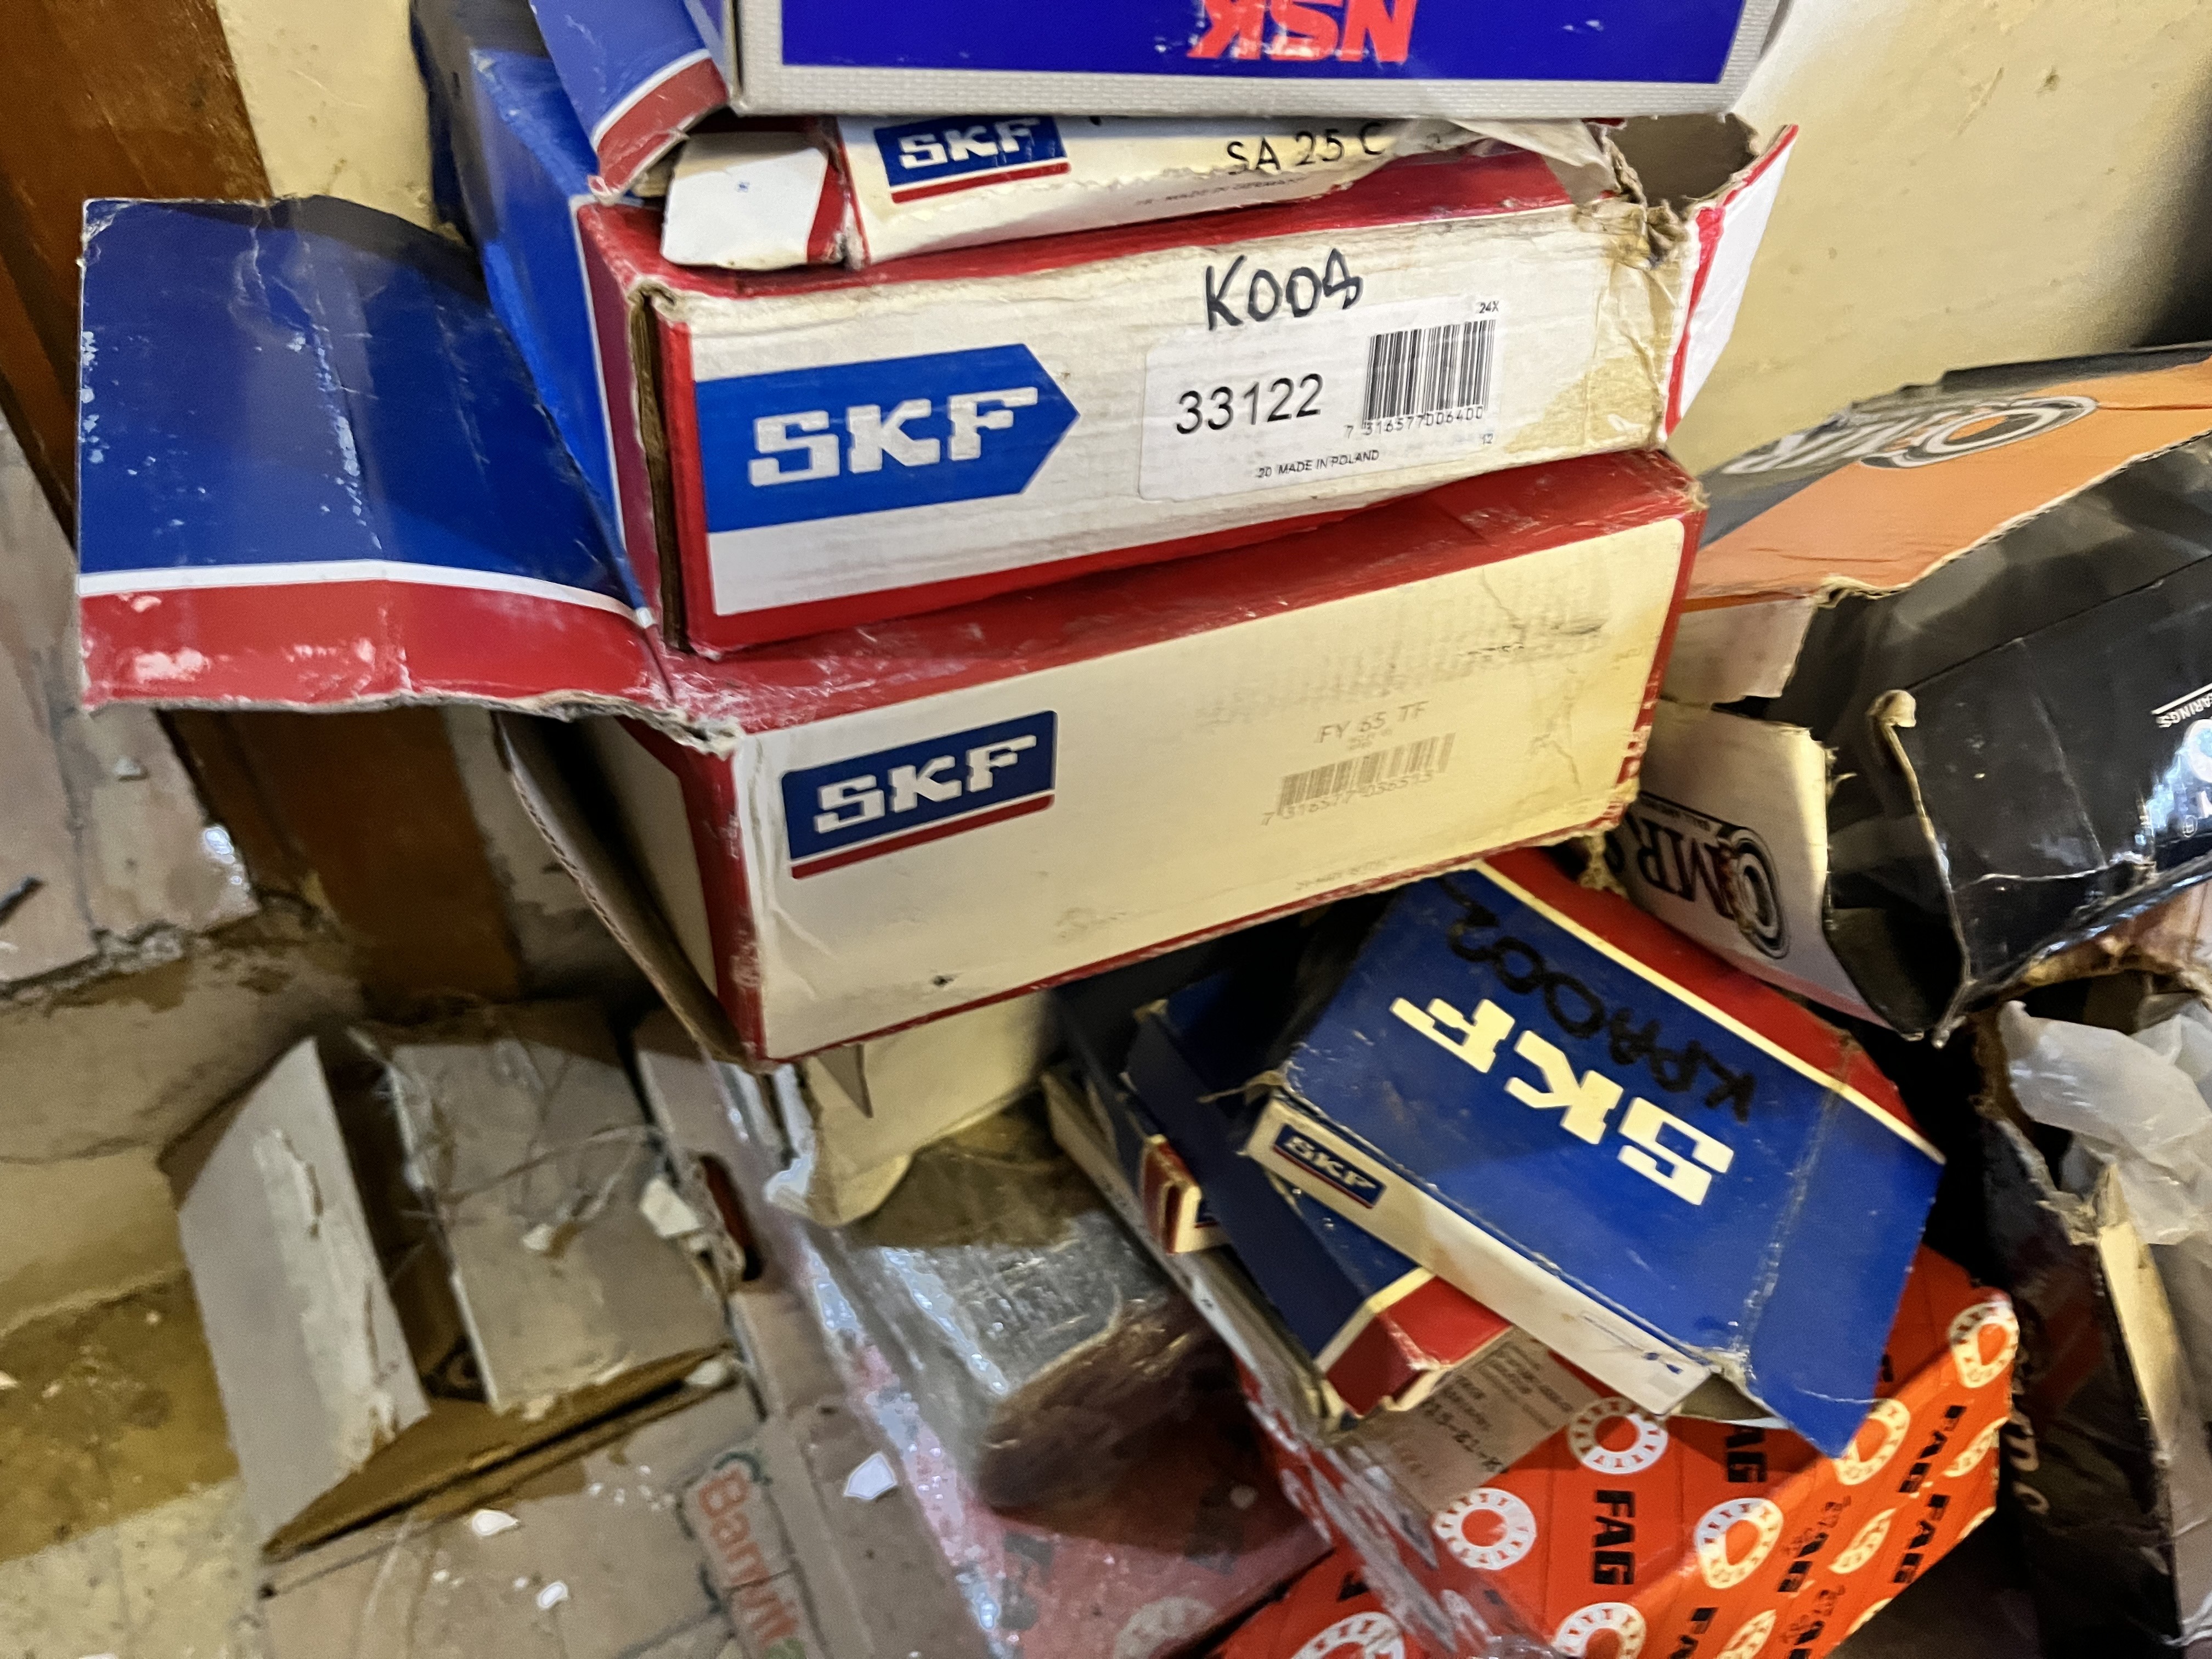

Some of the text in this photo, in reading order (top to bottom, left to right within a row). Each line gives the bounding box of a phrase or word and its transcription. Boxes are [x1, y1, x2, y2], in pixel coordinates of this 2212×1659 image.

[1187, 0, 1417, 63] NSK
[899, 117, 1040, 170] SKF
[1227, 136, 1281, 175] SA
[1295, 128, 1344, 166] 25
[1479, 300, 1500, 314] 24X
[1176, 373, 1324, 435] 33122
[748, 386, 1038, 488] SKF
[1278, 459, 1313, 474] MADE
[1317, 458, 1329, 470] IN
[1330, 449, 1380, 468] POLAND
[1314, 720, 1352, 743] FY
[1397, 699, 1430, 723] TF
[813, 735, 1037, 834] SKF
[1389, 997, 1735, 1205] SKF
[1284, 1136, 1377, 1189] SKF
[1725, 1426, 1767, 1483] AG
[1593, 1489, 1637, 1585] FAG
